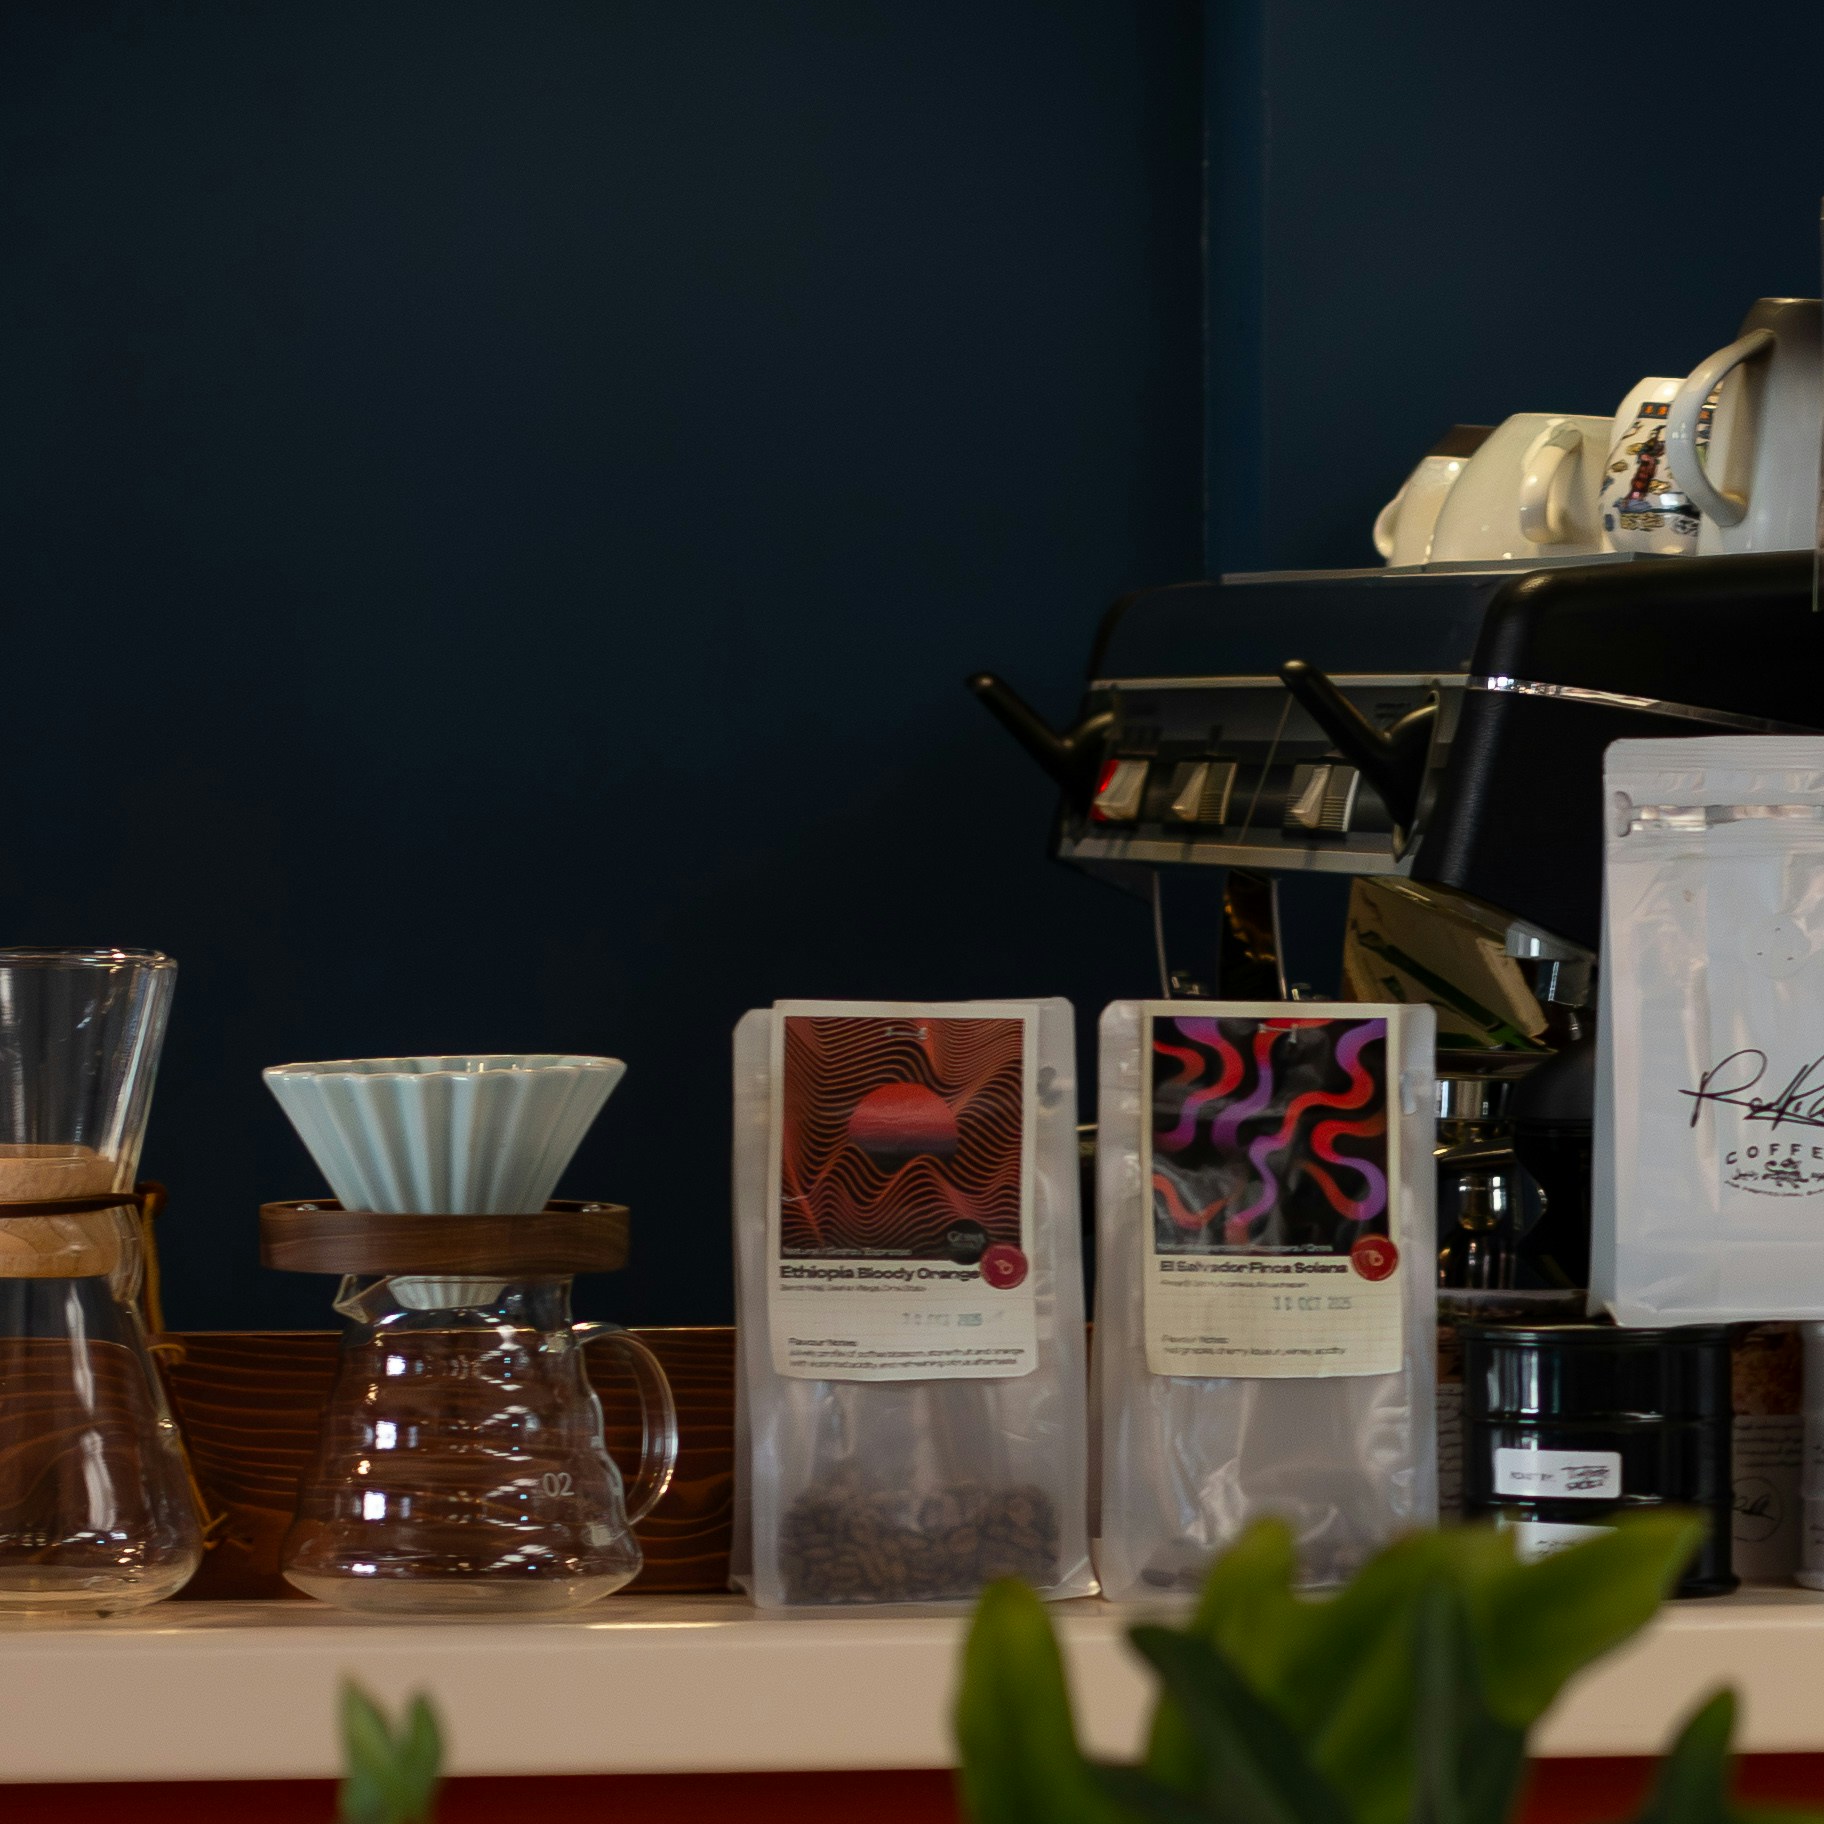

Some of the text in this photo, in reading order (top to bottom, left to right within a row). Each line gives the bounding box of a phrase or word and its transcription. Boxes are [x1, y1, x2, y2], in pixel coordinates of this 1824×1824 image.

[780, 1265, 981, 1282] Ethiopia Bloody Orange
[543, 1472, 575, 1497] 02
